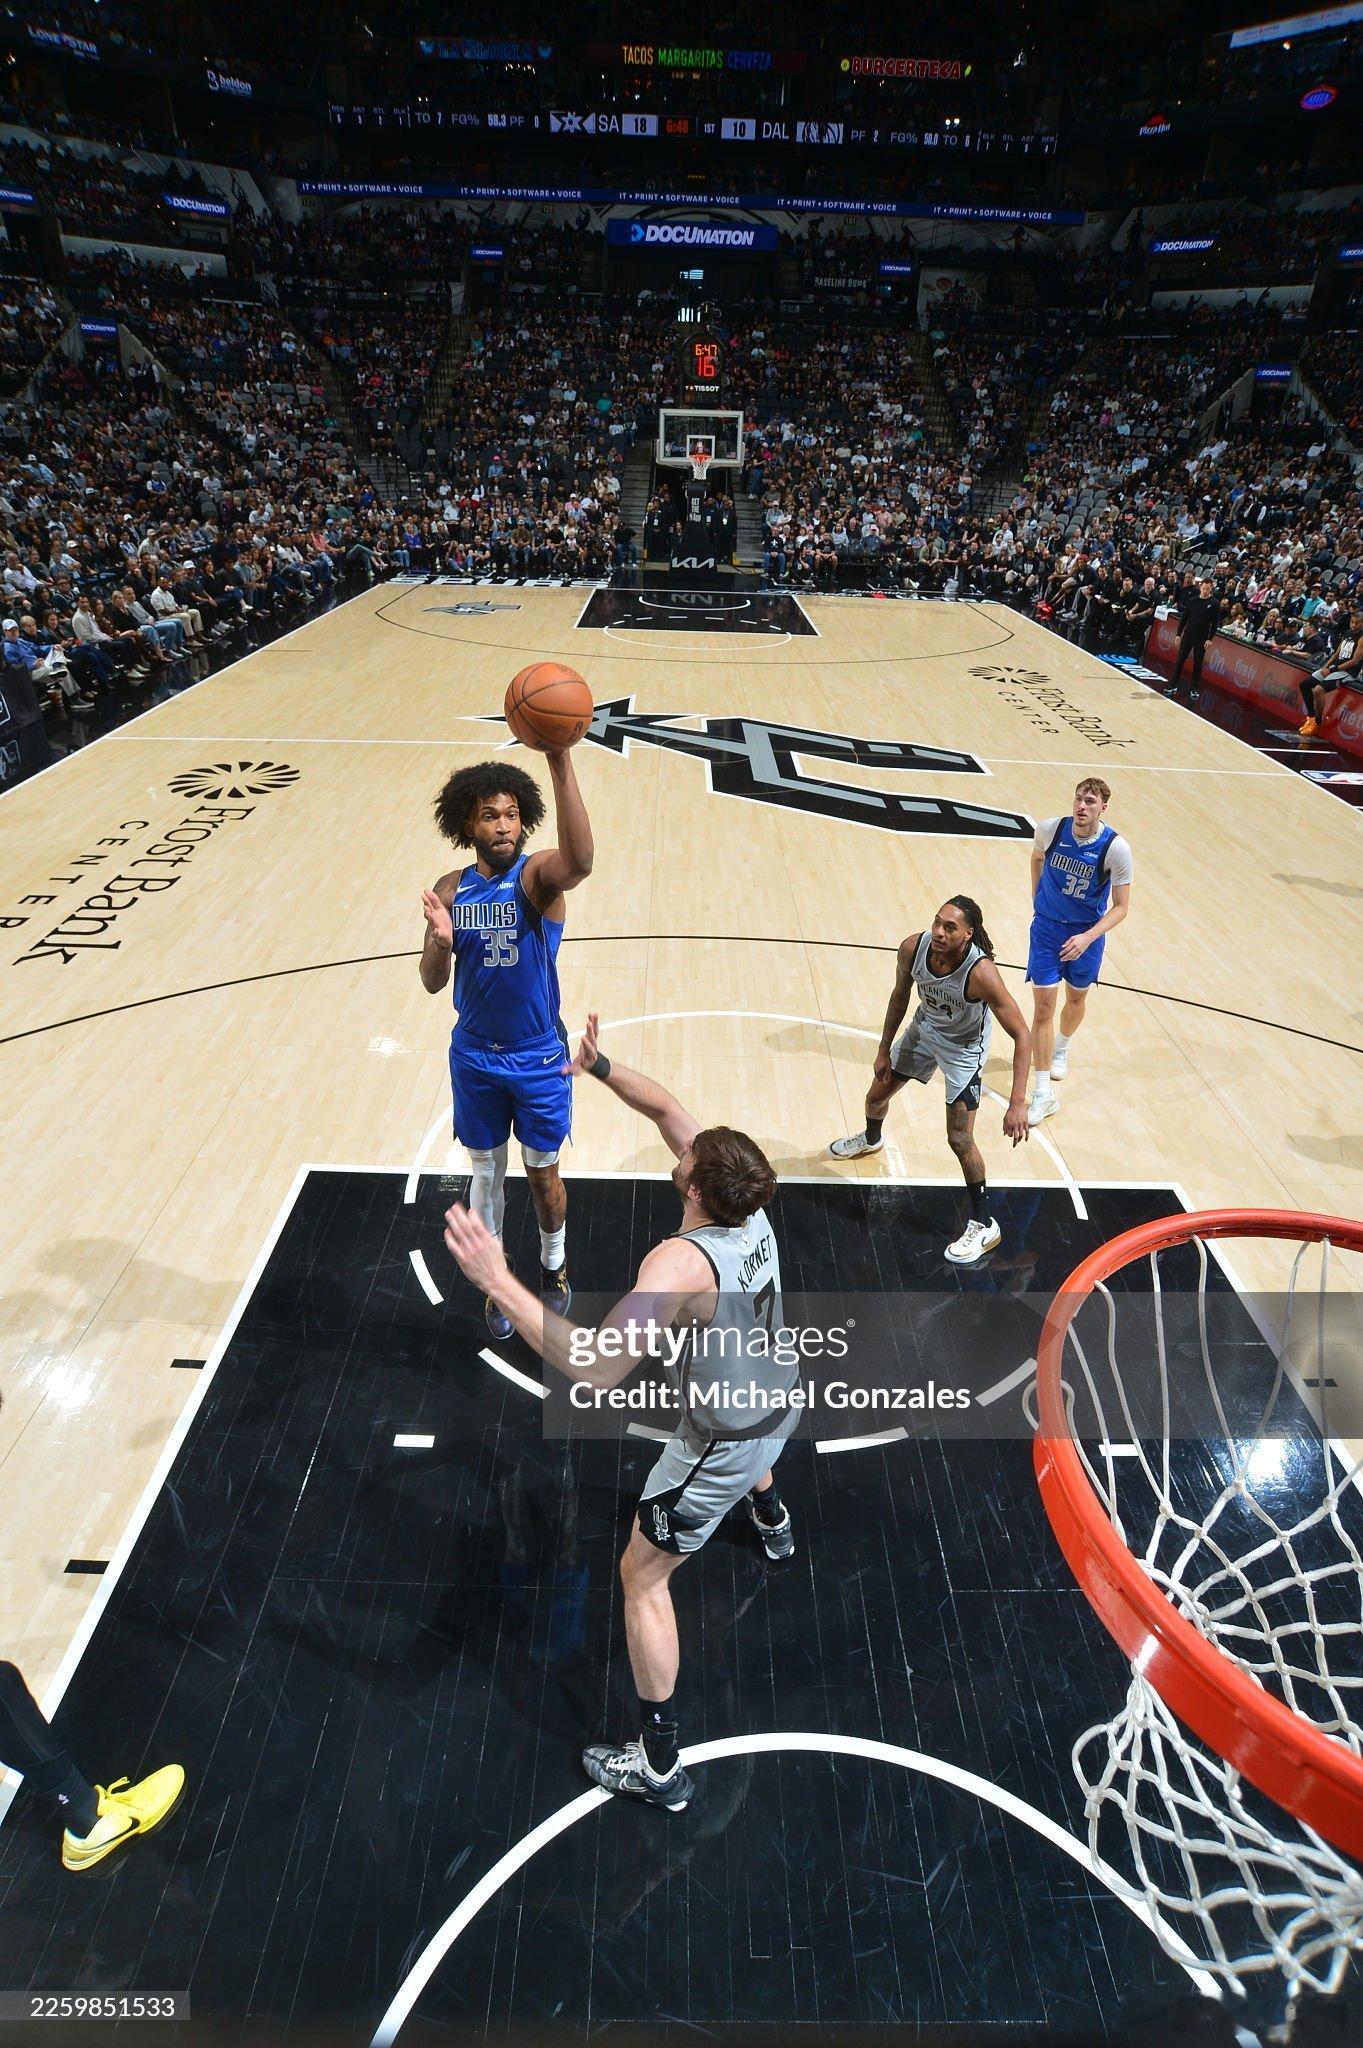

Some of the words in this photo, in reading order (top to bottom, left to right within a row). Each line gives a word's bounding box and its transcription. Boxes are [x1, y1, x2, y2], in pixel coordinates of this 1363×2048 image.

[622, 45, 653, 65] TACOS
[658, 48, 724, 69] MARGARITAS
[415, 112, 431, 125] TO
[452, 113, 480, 126] FG%
[510, 116, 525, 126] PF
[599, 115, 620, 133] SA
[634, 117, 647, 133] 18
[666, 118, 689, 136] 6:48
[704, 123, 715, 134] 1ST
[733, 121, 746, 137] 10
[762, 122, 789, 140] DAL
[850, 130, 866, 141] PF
[873, 129, 879, 143] 2
[890, 132, 918, 144] FG%
[943, 135, 958, 146] TO
[302, 182, 310, 190] IT
[318, 183, 341, 191] PRINT
[349, 184, 391, 193] SOFTWARE
[399, 185, 424, 194] VOICE
[460, 187, 468, 195] IT
[476, 187, 500, 196] PRINT
[507, 188, 550, 197] SOFTWARE
[557, 190, 582, 198] VOICE
[619, 192, 626, 200] IT
[635, 193, 658, 201] PRINT
[665, 194, 707, 203] SOFTWARE
[716, 196, 740, 204] VOICE
[173, 196, 226, 215] DOCUMATION
[777, 198, 784, 206] IT
[792, 199, 816, 208] PRINT
[823, 201, 865, 210] SOFTWARE
[872, 203, 896, 212] VOICE
[933, 206, 941, 214] IT
[949, 207, 972, 216] PRINT
[979, 208, 1021, 218] SOFTWARE
[1028, 211, 1052, 220] VOICE
[645, 224, 755, 246] DOCUMATION
[1160, 239, 1215, 252] DOCUMATION
[815, 276, 846, 288] BASELINE
[848, 278, 867, 289] BUMS
[698, 356, 715, 377] 16
[671, 556, 715, 569] KIA
[998, 691, 1060, 734] CENTER
[1023, 686, 1084, 714] Frost
[1059, 714, 1137, 748] Bank
[130, 805, 256, 868] Frost
[0, 820, 150, 928] CENTER
[1050, 852, 1095, 879] DALLAS
[1062, 874, 1090, 900] 32
[12, 874, 182, 966] Bank
[453, 901, 517, 930] DALLAS
[480, 930, 519, 967] 35
[737, 1234, 772, 1295] KORNET
[752, 1275, 777, 1356] 7
